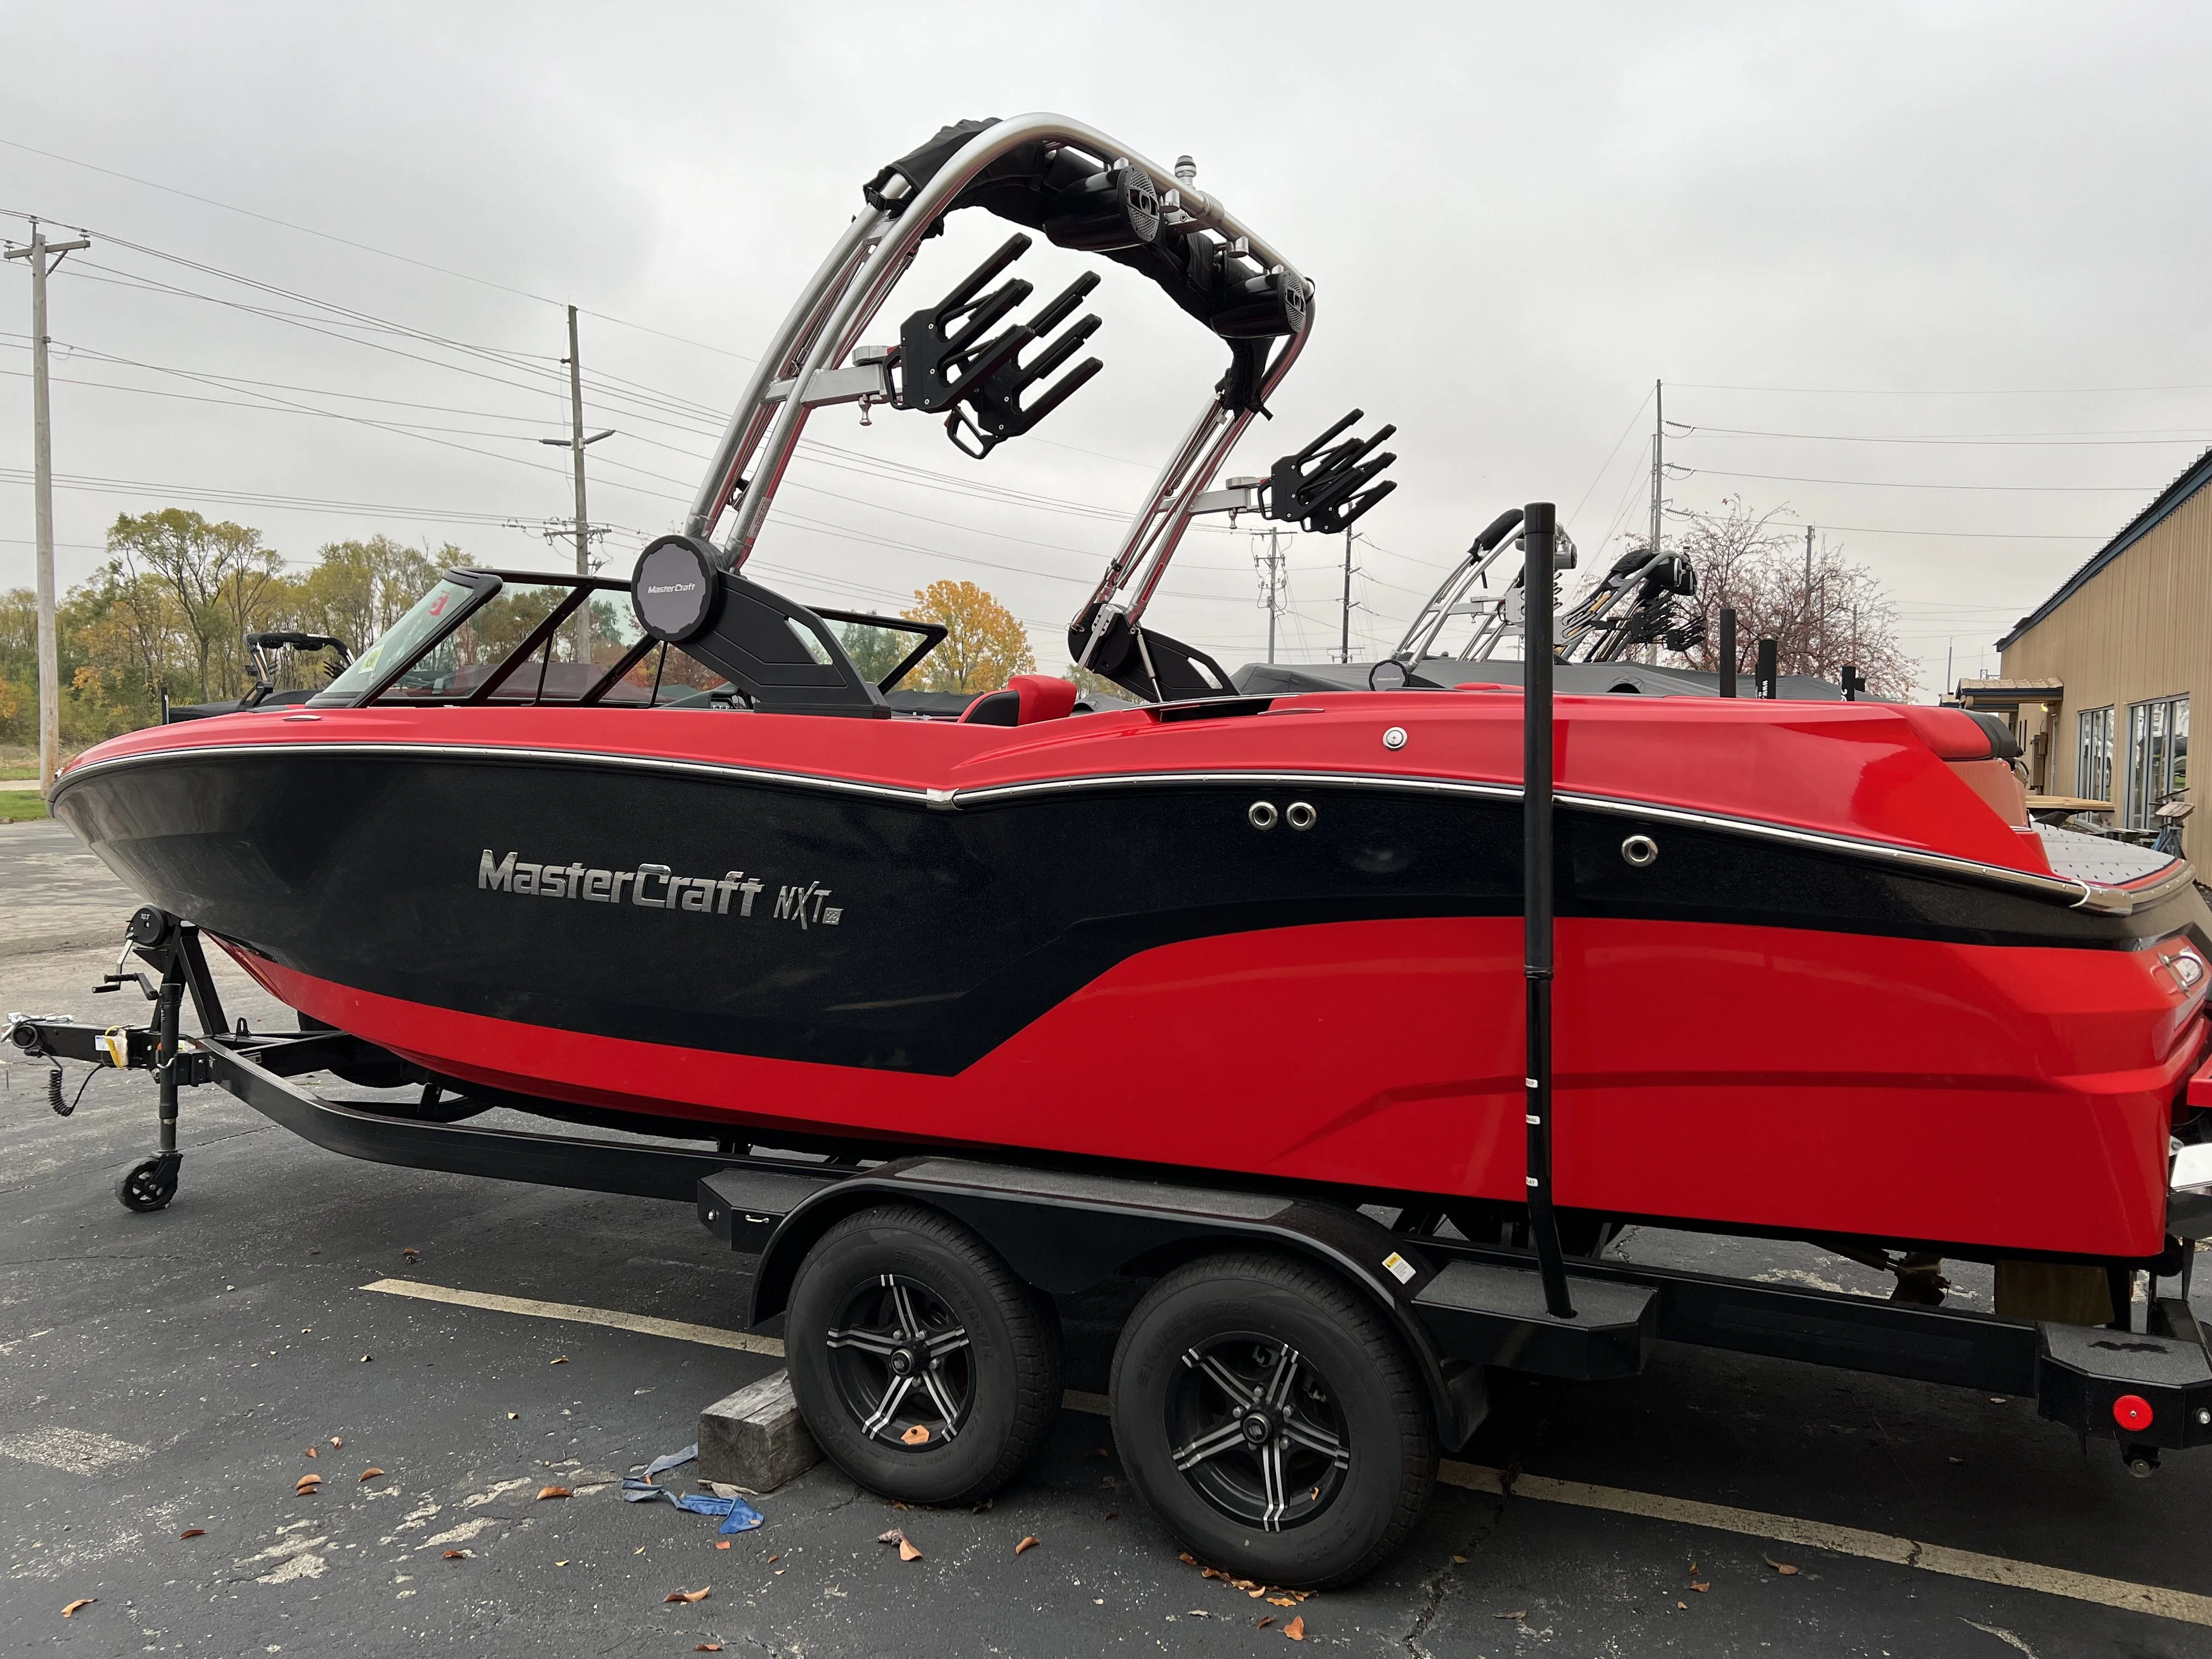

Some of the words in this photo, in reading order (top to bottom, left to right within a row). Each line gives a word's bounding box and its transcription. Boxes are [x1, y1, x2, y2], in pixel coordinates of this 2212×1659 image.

[647, 583, 696, 594] MasterCraft
[478, 849, 765, 917] MasterCraft
[773, 881, 832, 930] NXT
